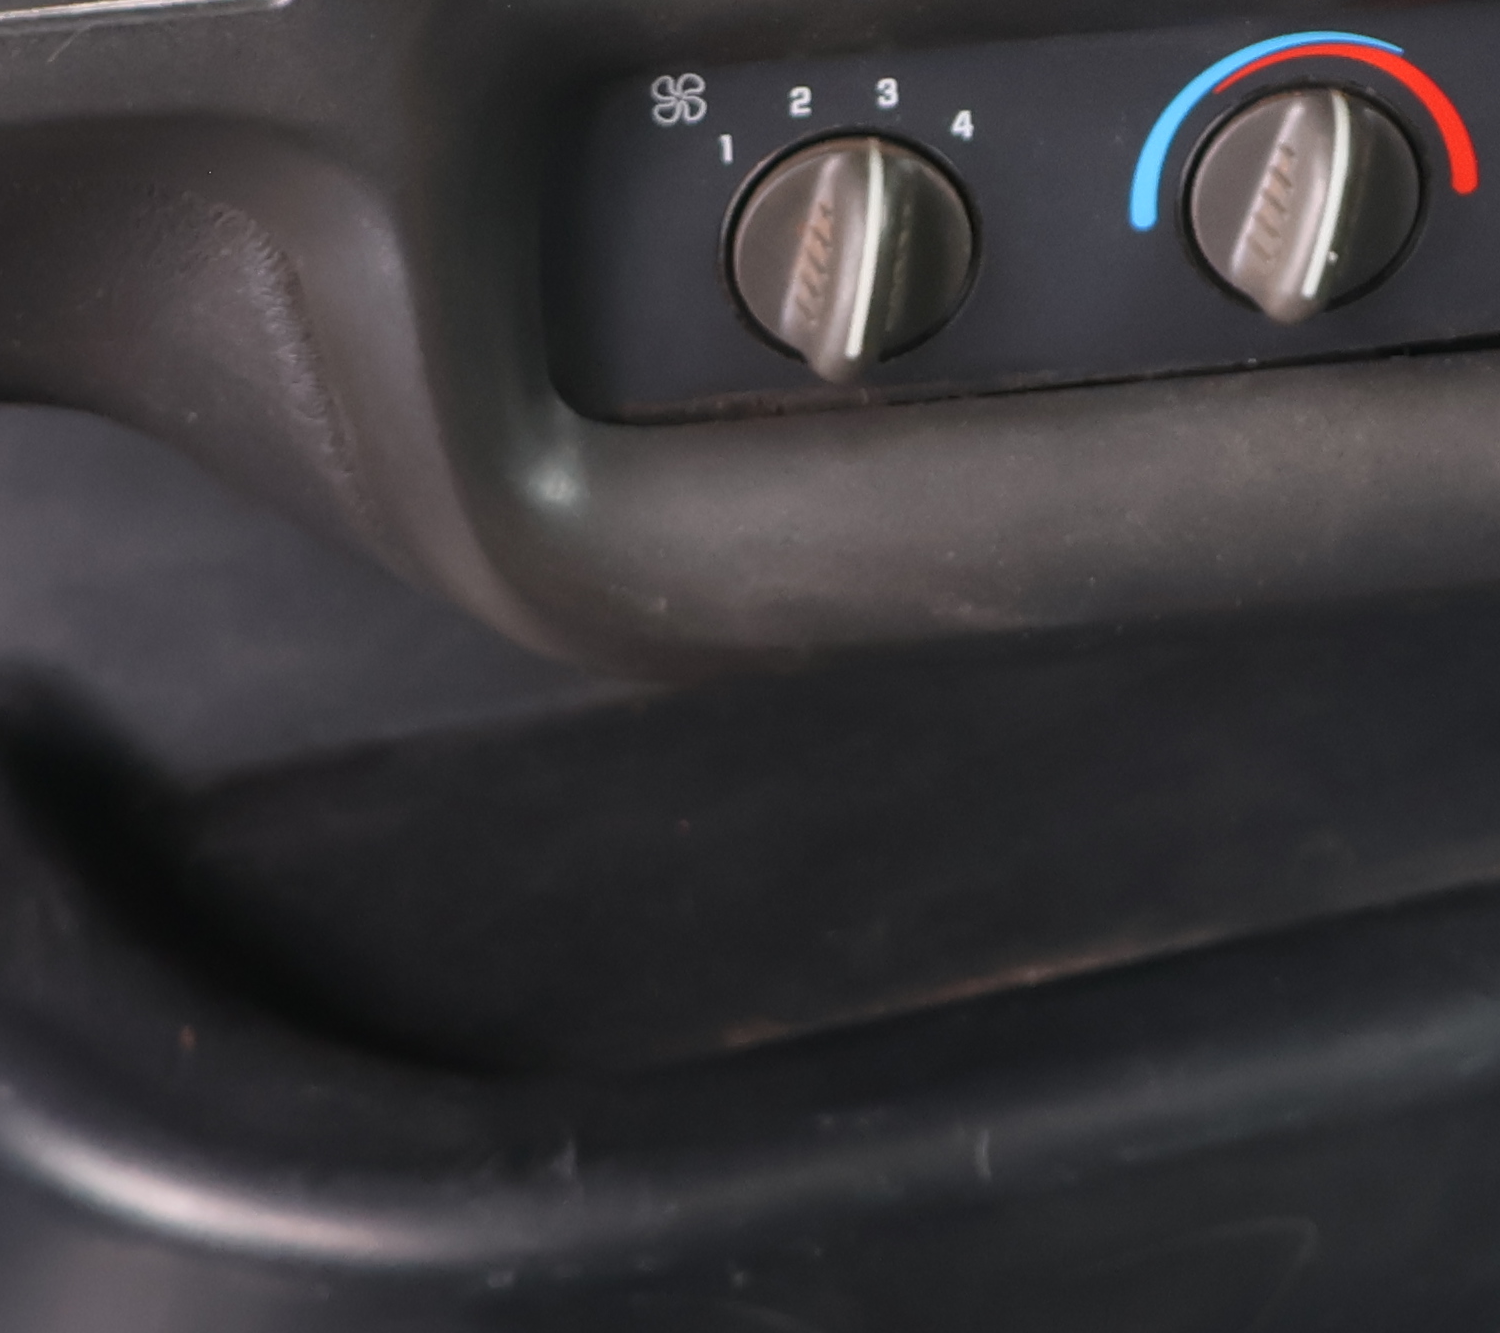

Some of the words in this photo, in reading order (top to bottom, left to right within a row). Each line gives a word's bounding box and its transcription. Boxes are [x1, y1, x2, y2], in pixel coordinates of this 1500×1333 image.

[789, 86, 812, 116] 2
[876, 78, 899, 108] 3
[951, 110, 975, 140] 4
[719, 134, 734, 164] 1
